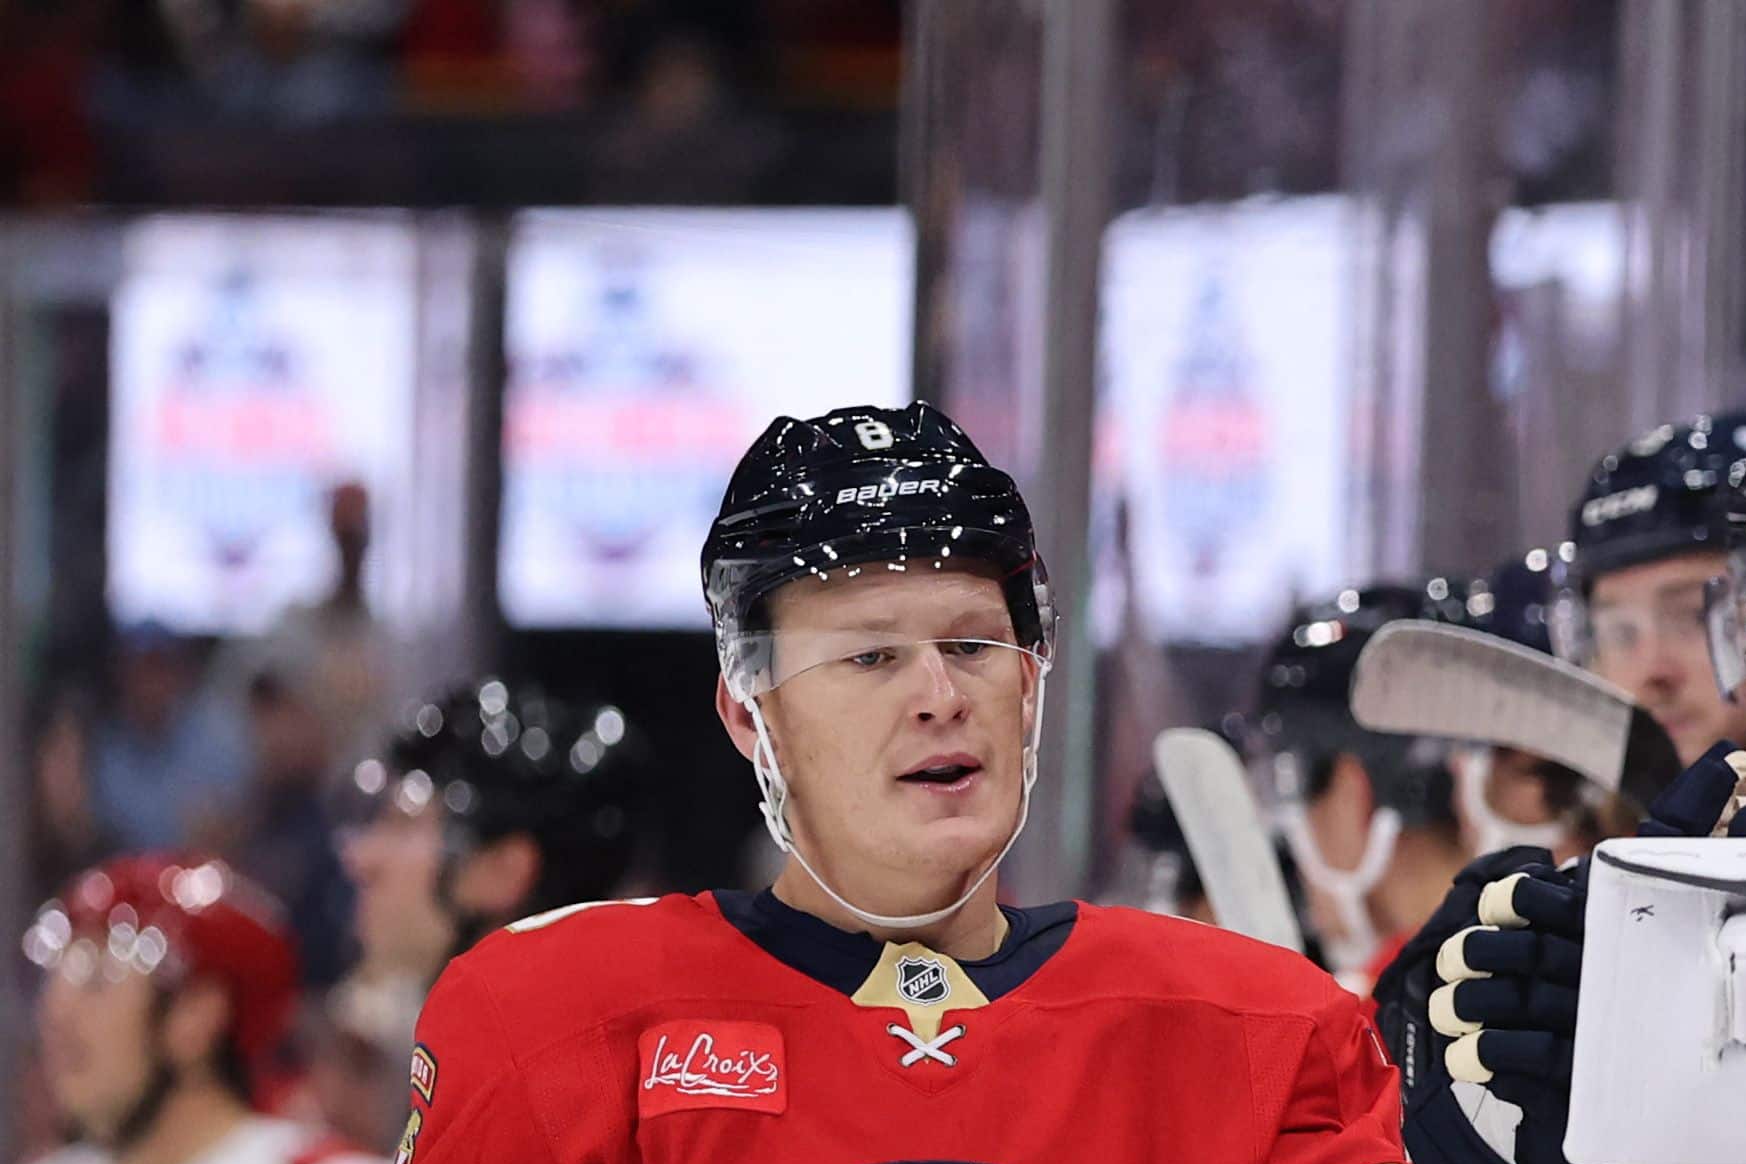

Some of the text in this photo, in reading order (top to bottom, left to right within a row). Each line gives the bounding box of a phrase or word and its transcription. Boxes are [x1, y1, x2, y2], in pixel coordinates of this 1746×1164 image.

[854, 421, 895, 450] 8
[836, 480, 941, 504] BAUER
[908, 970, 939, 996] NHL
[645, 1032, 778, 1097] LaCroix
